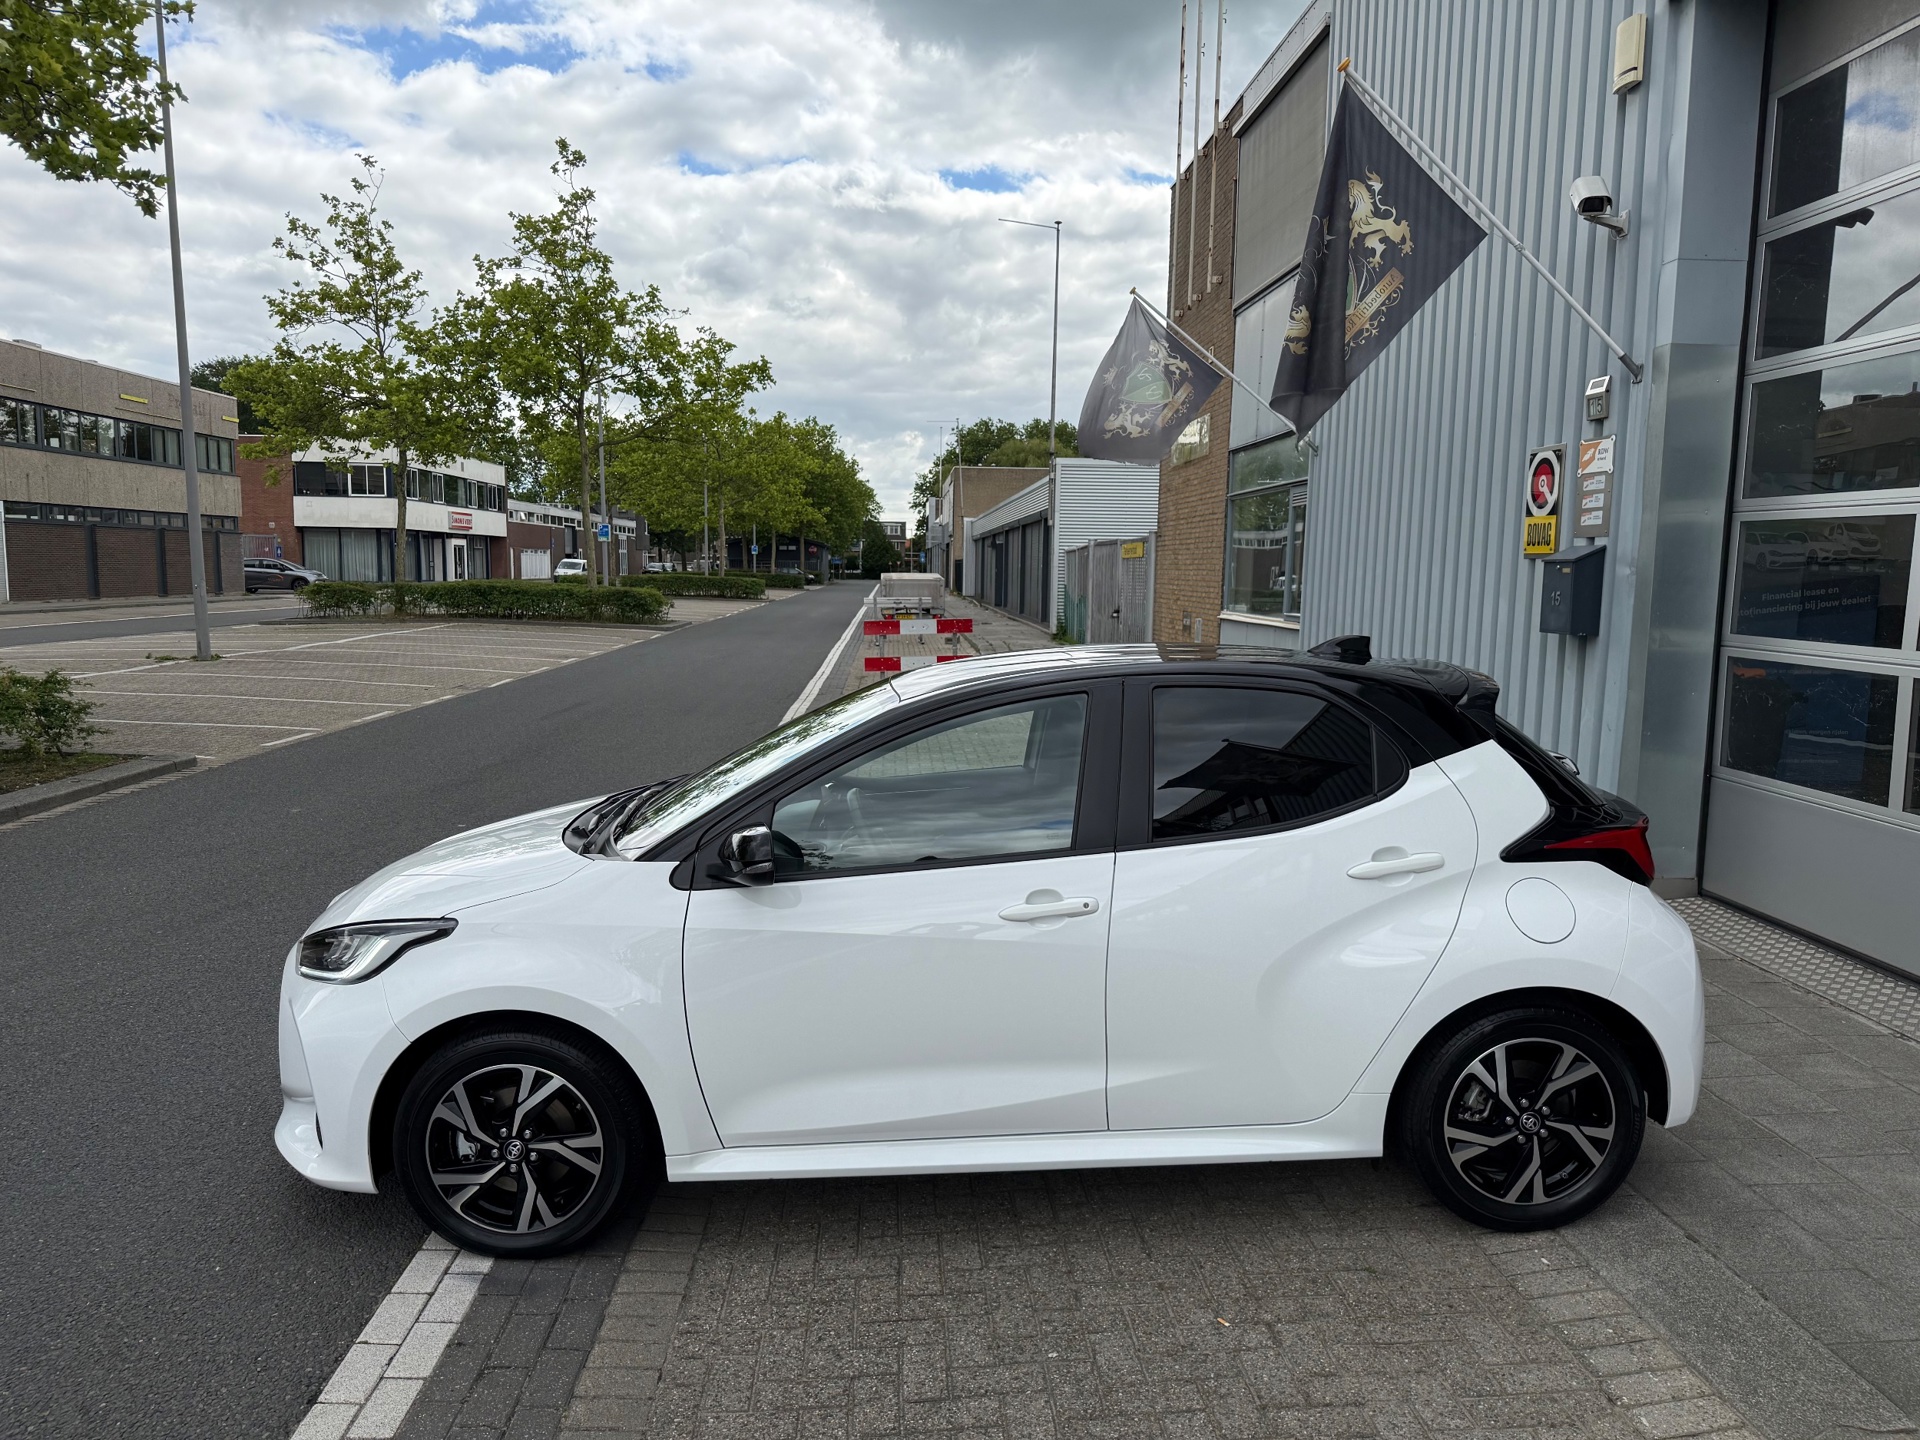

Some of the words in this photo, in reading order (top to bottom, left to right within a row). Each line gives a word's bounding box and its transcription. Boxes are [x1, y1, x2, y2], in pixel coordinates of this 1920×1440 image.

[1590, 398, 1602, 416] 15
[1527, 522, 1552, 546] BOVAG
[1550, 591, 1561, 606] 15
[1762, 589, 1801, 601] Financial
[1804, 588, 1826, 597] lease
[1805, 600, 1816, 610] bij
[1817, 598, 1840, 610] jouw
[1841, 595, 1871, 605] dealer!
